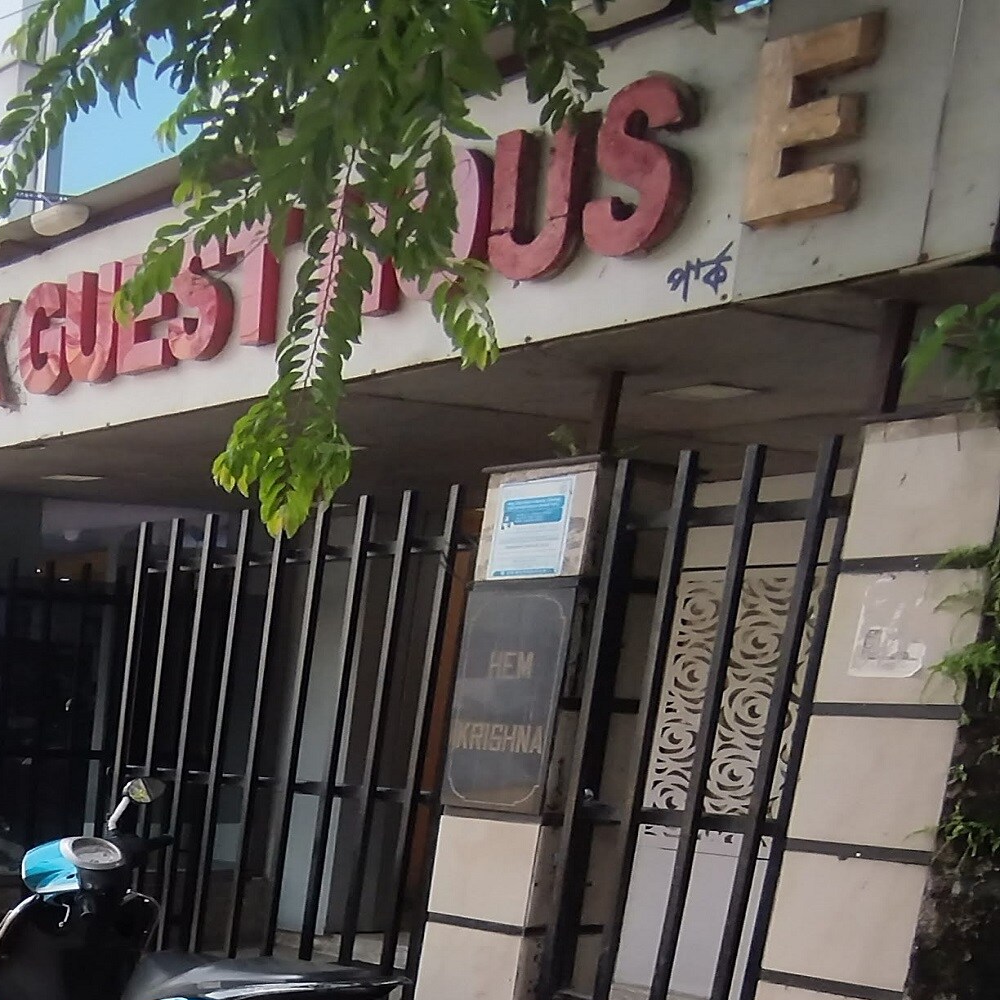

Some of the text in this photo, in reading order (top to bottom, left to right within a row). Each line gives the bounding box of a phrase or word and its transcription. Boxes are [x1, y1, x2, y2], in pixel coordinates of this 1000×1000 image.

[18, 195, 304, 396] GUEST
[488, 650, 535, 680] HEM
[451, 721, 543, 754] KRISHNA
